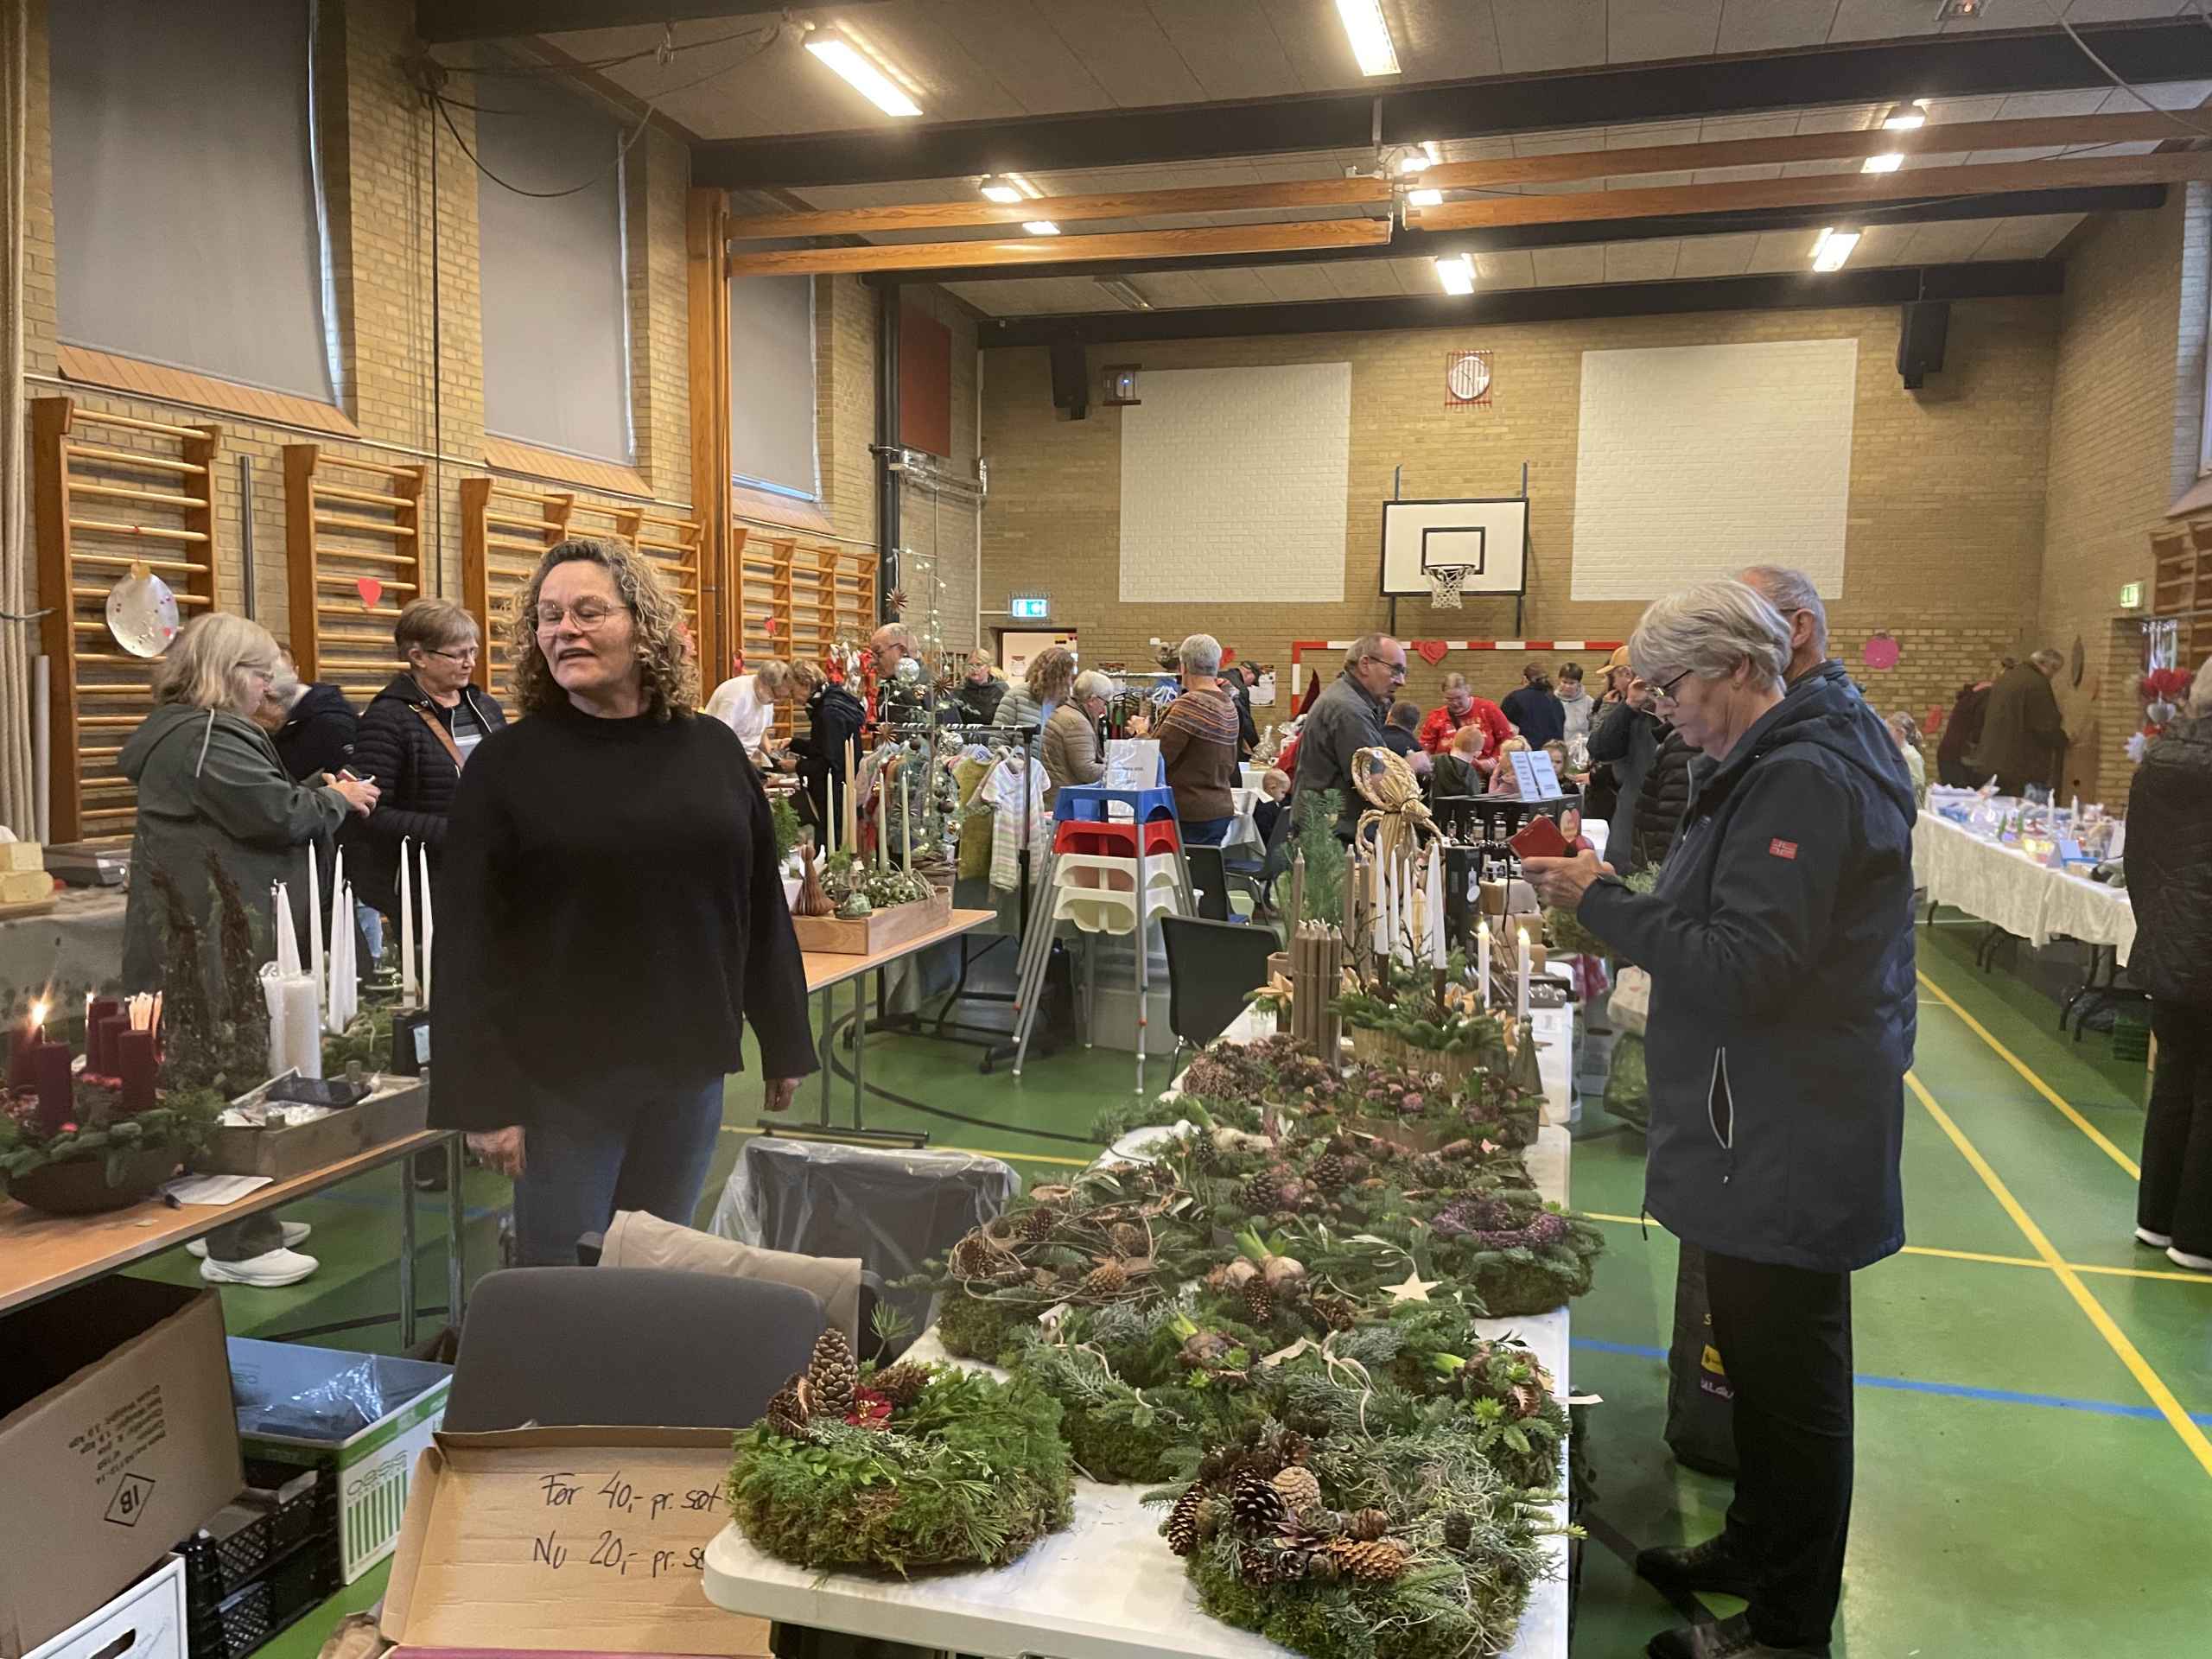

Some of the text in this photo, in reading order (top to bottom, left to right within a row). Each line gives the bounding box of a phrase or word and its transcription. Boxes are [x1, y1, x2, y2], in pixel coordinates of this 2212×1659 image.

[597, 1471, 644, 1513] 40,-
[651, 1492, 673, 1520] pr.
[533, 1529, 567, 1569] Nu
[589, 1530, 639, 1575] 20,-
[652, 1551, 676, 1578] pr.
